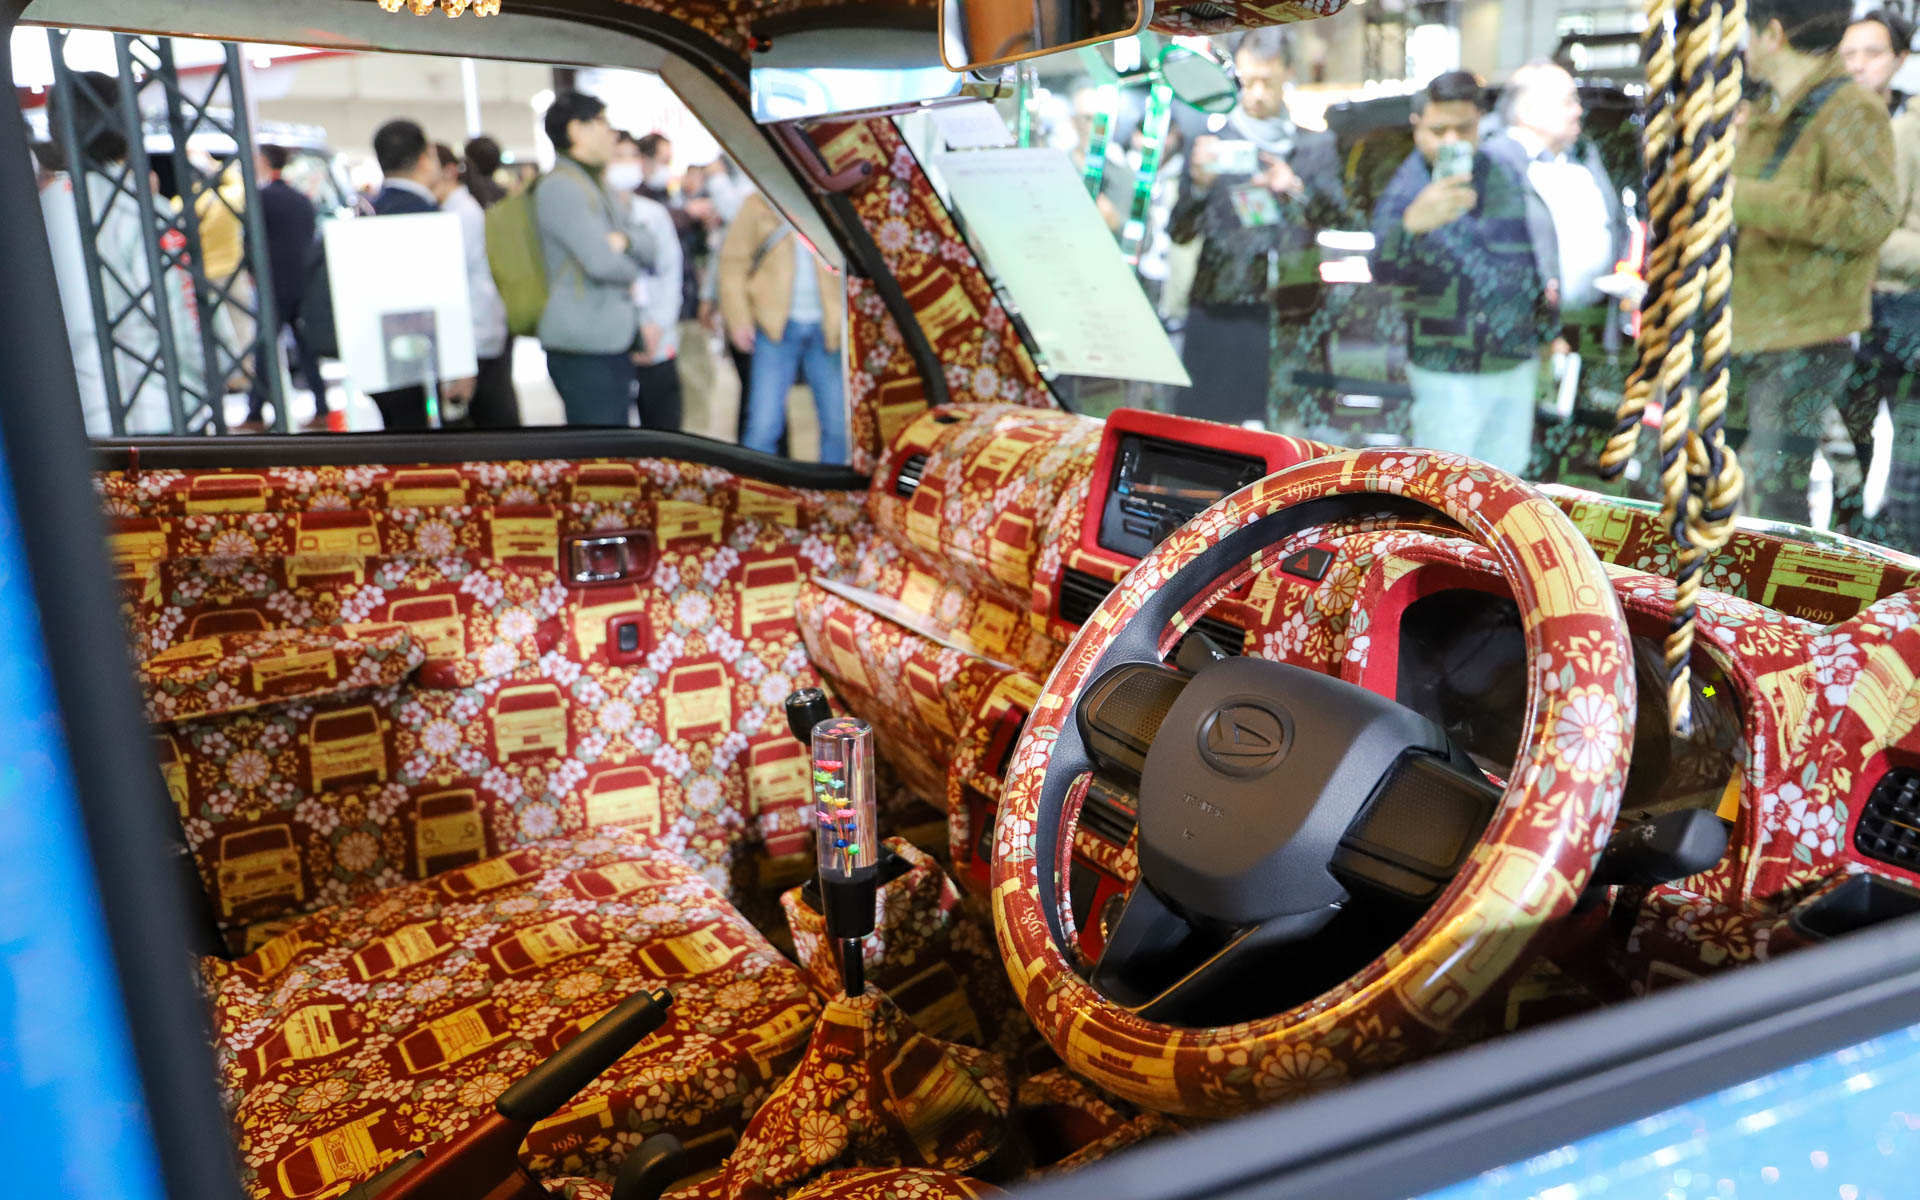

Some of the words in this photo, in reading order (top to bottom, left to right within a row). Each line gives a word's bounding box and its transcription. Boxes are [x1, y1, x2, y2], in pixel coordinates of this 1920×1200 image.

[1286, 481, 1322, 501] 1999
[1794, 604, 1835, 624] 1999
[1073, 642, 1100, 677] 1968
[1021, 905, 1044, 938] 1981
[552, 1133, 583, 1151] 1981
